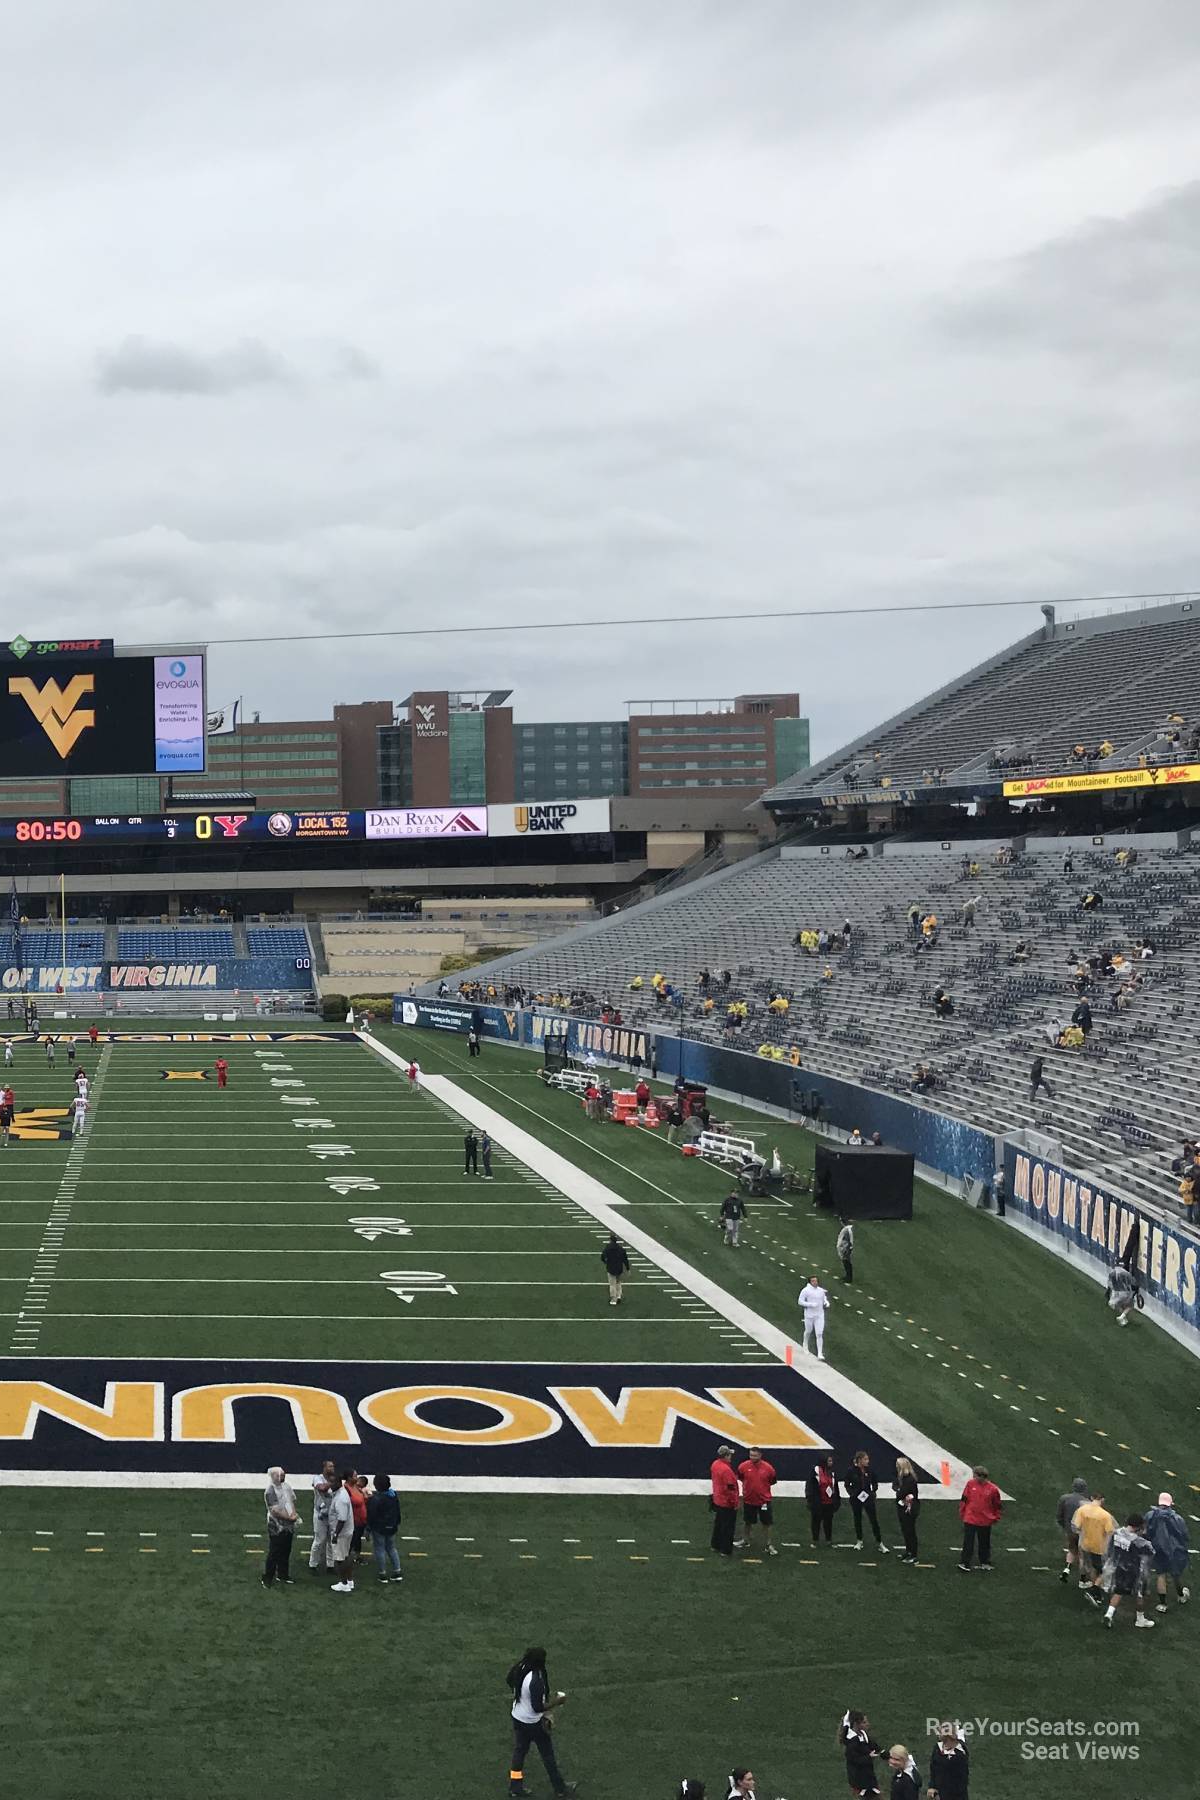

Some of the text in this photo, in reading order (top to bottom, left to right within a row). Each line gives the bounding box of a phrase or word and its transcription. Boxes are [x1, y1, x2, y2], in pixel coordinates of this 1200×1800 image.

[36, 640, 101, 655] gomart
[1012, 783, 1024, 792] Get
[1067, 776, 1109, 787] Mountaineer
[1114, 772, 1144, 783] Football!
[369, 811, 444, 827] DAN RYAN
[529, 804, 577, 818] UNITED
[16, 820, 81, 841] 80:50
[167, 827, 175, 838] 3
[196, 815, 211, 839] 0
[213, 815, 248, 837] Y
[299, 817, 347, 829] LOCAL 152
[376, 826, 438, 835] BUILDERS
[529, 817, 565, 831] BANK
[2, 967, 33, 989] OF
[38, 966, 102, 988] WEST
[110, 964, 217, 987] VIRGINIA
[532, 1016, 646, 1061] WEST VIRGINIA
[347, 1216, 414, 1236] 20
[1014, 1154, 1197, 1306] MOUNTAINEERS
[379, 1270, 459, 1295] 10
